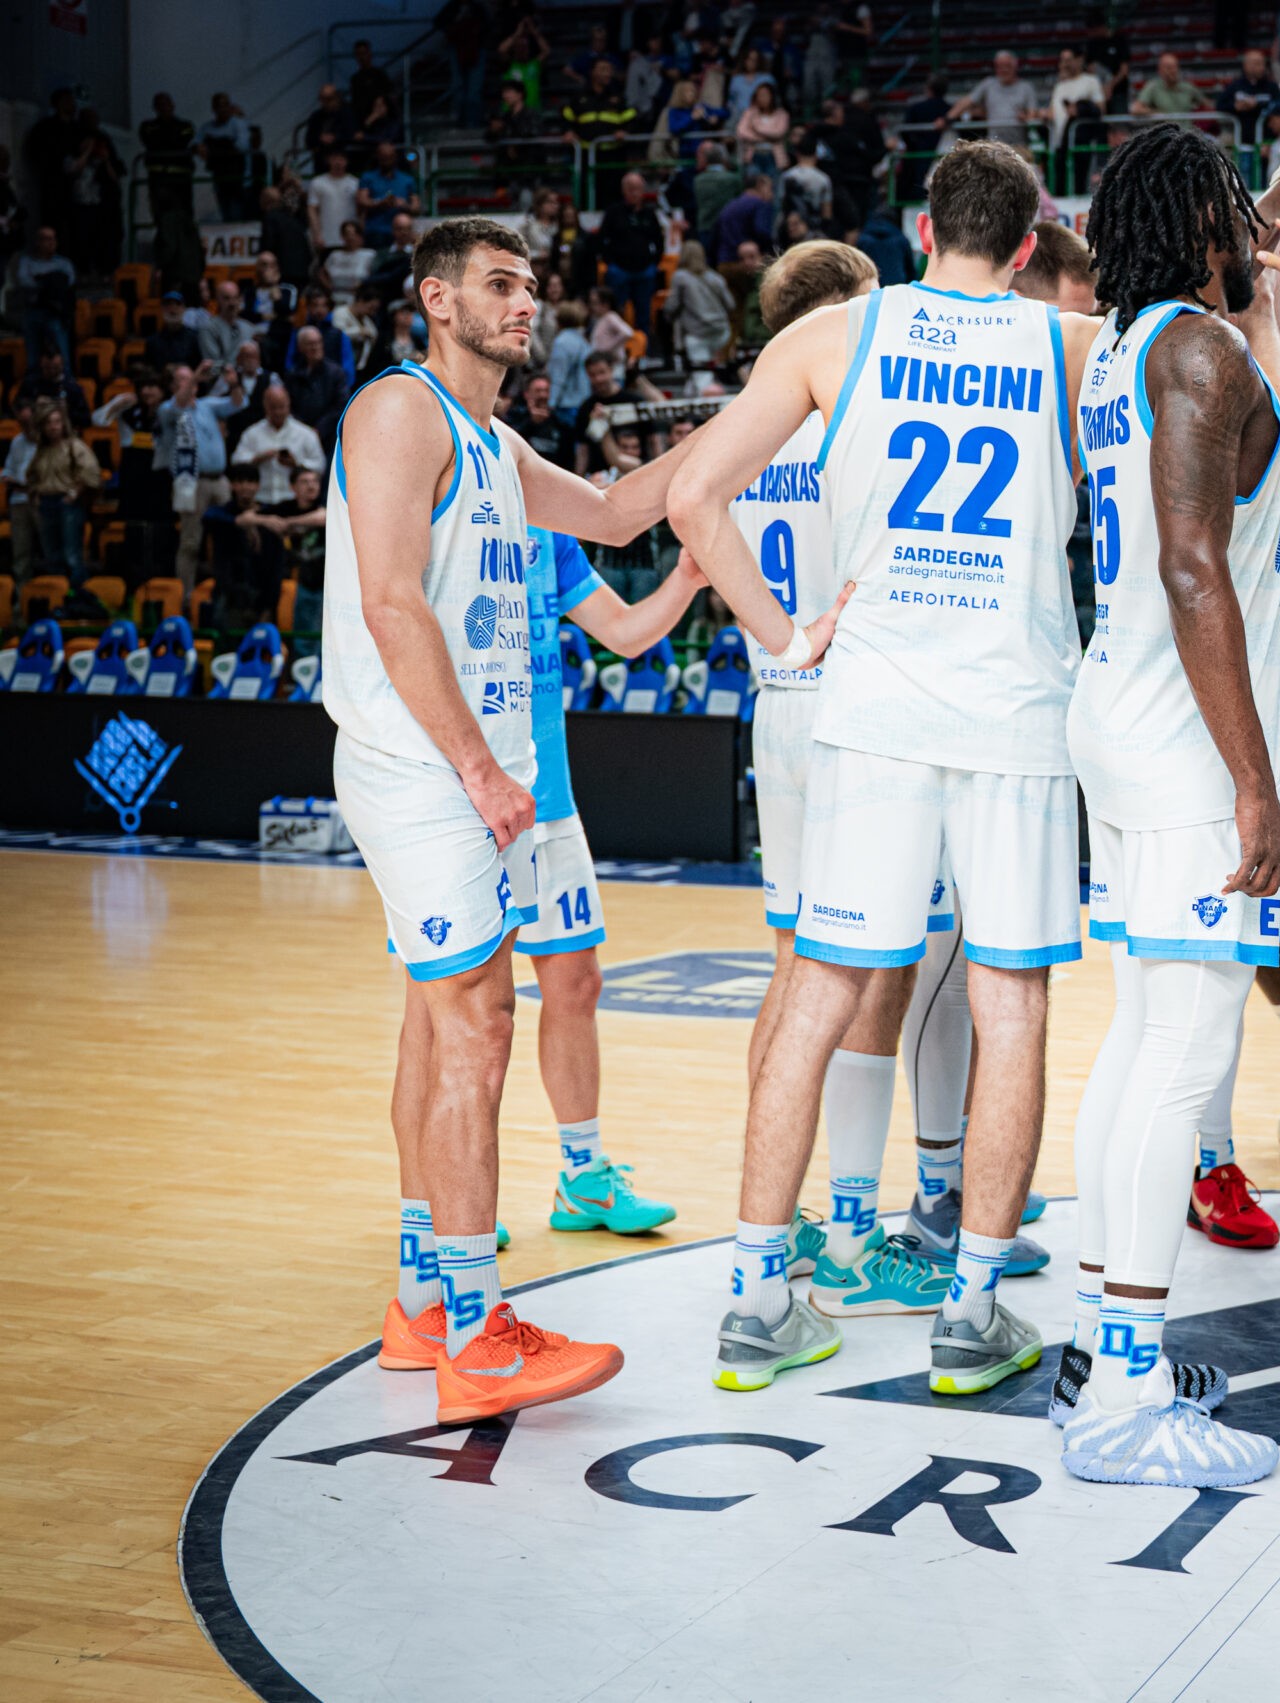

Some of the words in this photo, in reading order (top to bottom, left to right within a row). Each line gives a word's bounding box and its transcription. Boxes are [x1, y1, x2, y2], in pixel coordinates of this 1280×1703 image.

[936, 313, 1014, 326] ACRISURE
[909, 324, 957, 345] a2a
[880, 355, 1043, 413] VINCINI
[467, 441, 492, 491] 11
[887, 420, 1019, 538] 22
[761, 519, 797, 616] 9
[893, 545, 1004, 569] SARDEGNA
[888, 564, 1006, 584] sardegnaturismo.it
[889, 589, 999, 611] AEROITALIA
[557, 887, 591, 930] 14
[812, 904, 865, 922] SARDEGNA
